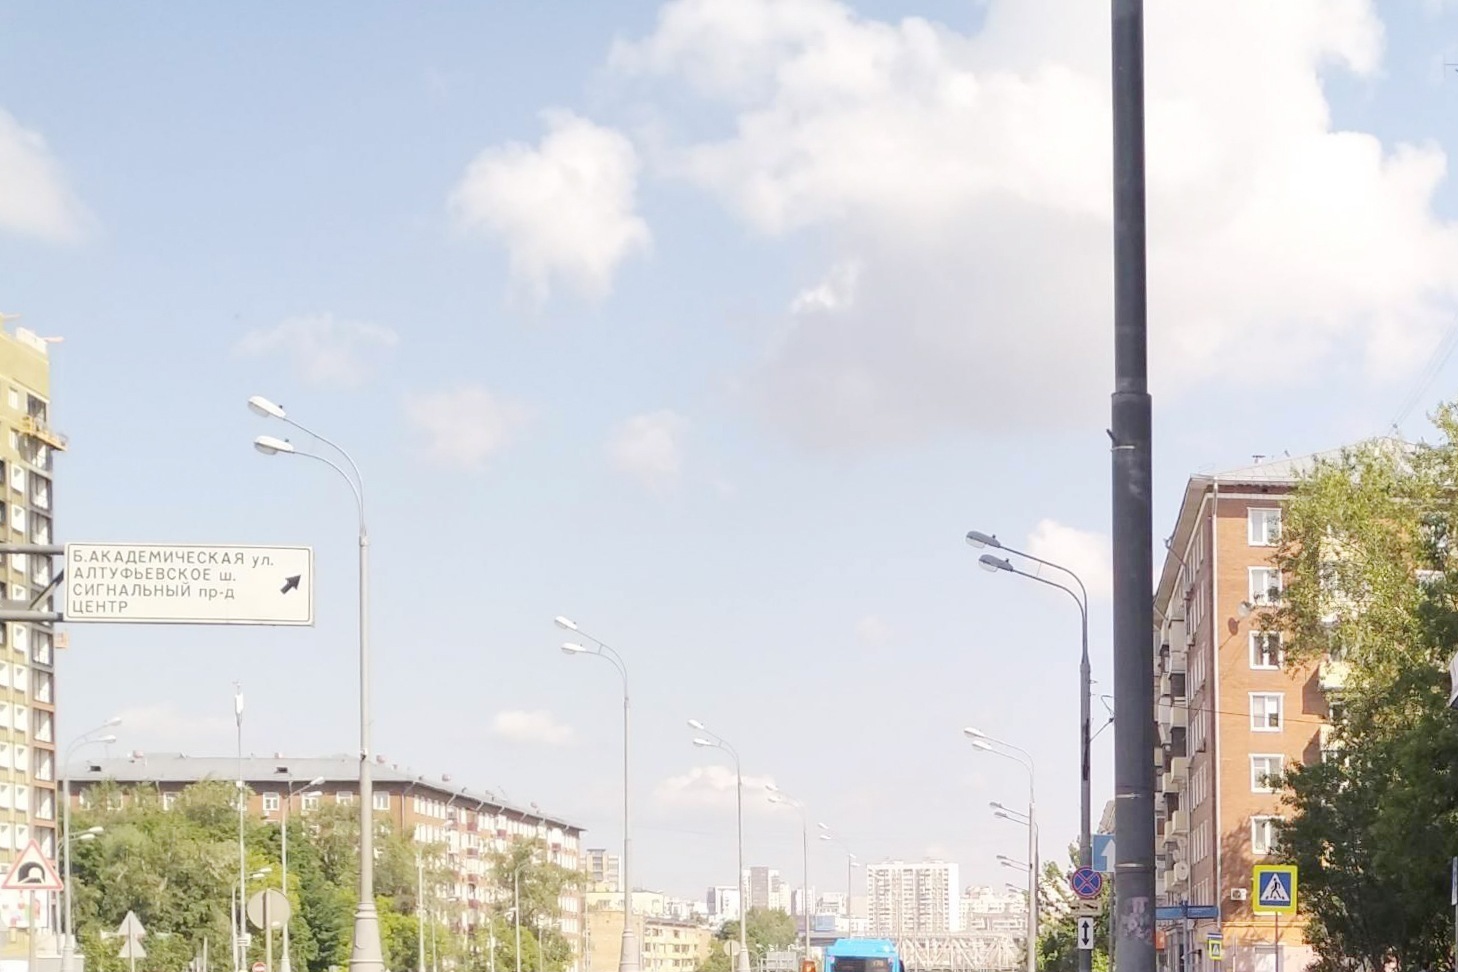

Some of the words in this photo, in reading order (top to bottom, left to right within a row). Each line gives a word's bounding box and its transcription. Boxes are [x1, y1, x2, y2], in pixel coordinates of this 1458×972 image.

[73, 549, 244, 565] Б.АКАДЕМИЧЕСКАЯ
[252, 556, 274, 568] ул.
[74, 567, 211, 581] АЛТУФЬЕВСКОЕ
[219, 571, 236, 581] ш.
[73, 582, 191, 597] СИГНАЛЬНЫЙ
[199, 587, 235, 600] пр-д
[73, 600, 128, 613] ЦЕНТР
